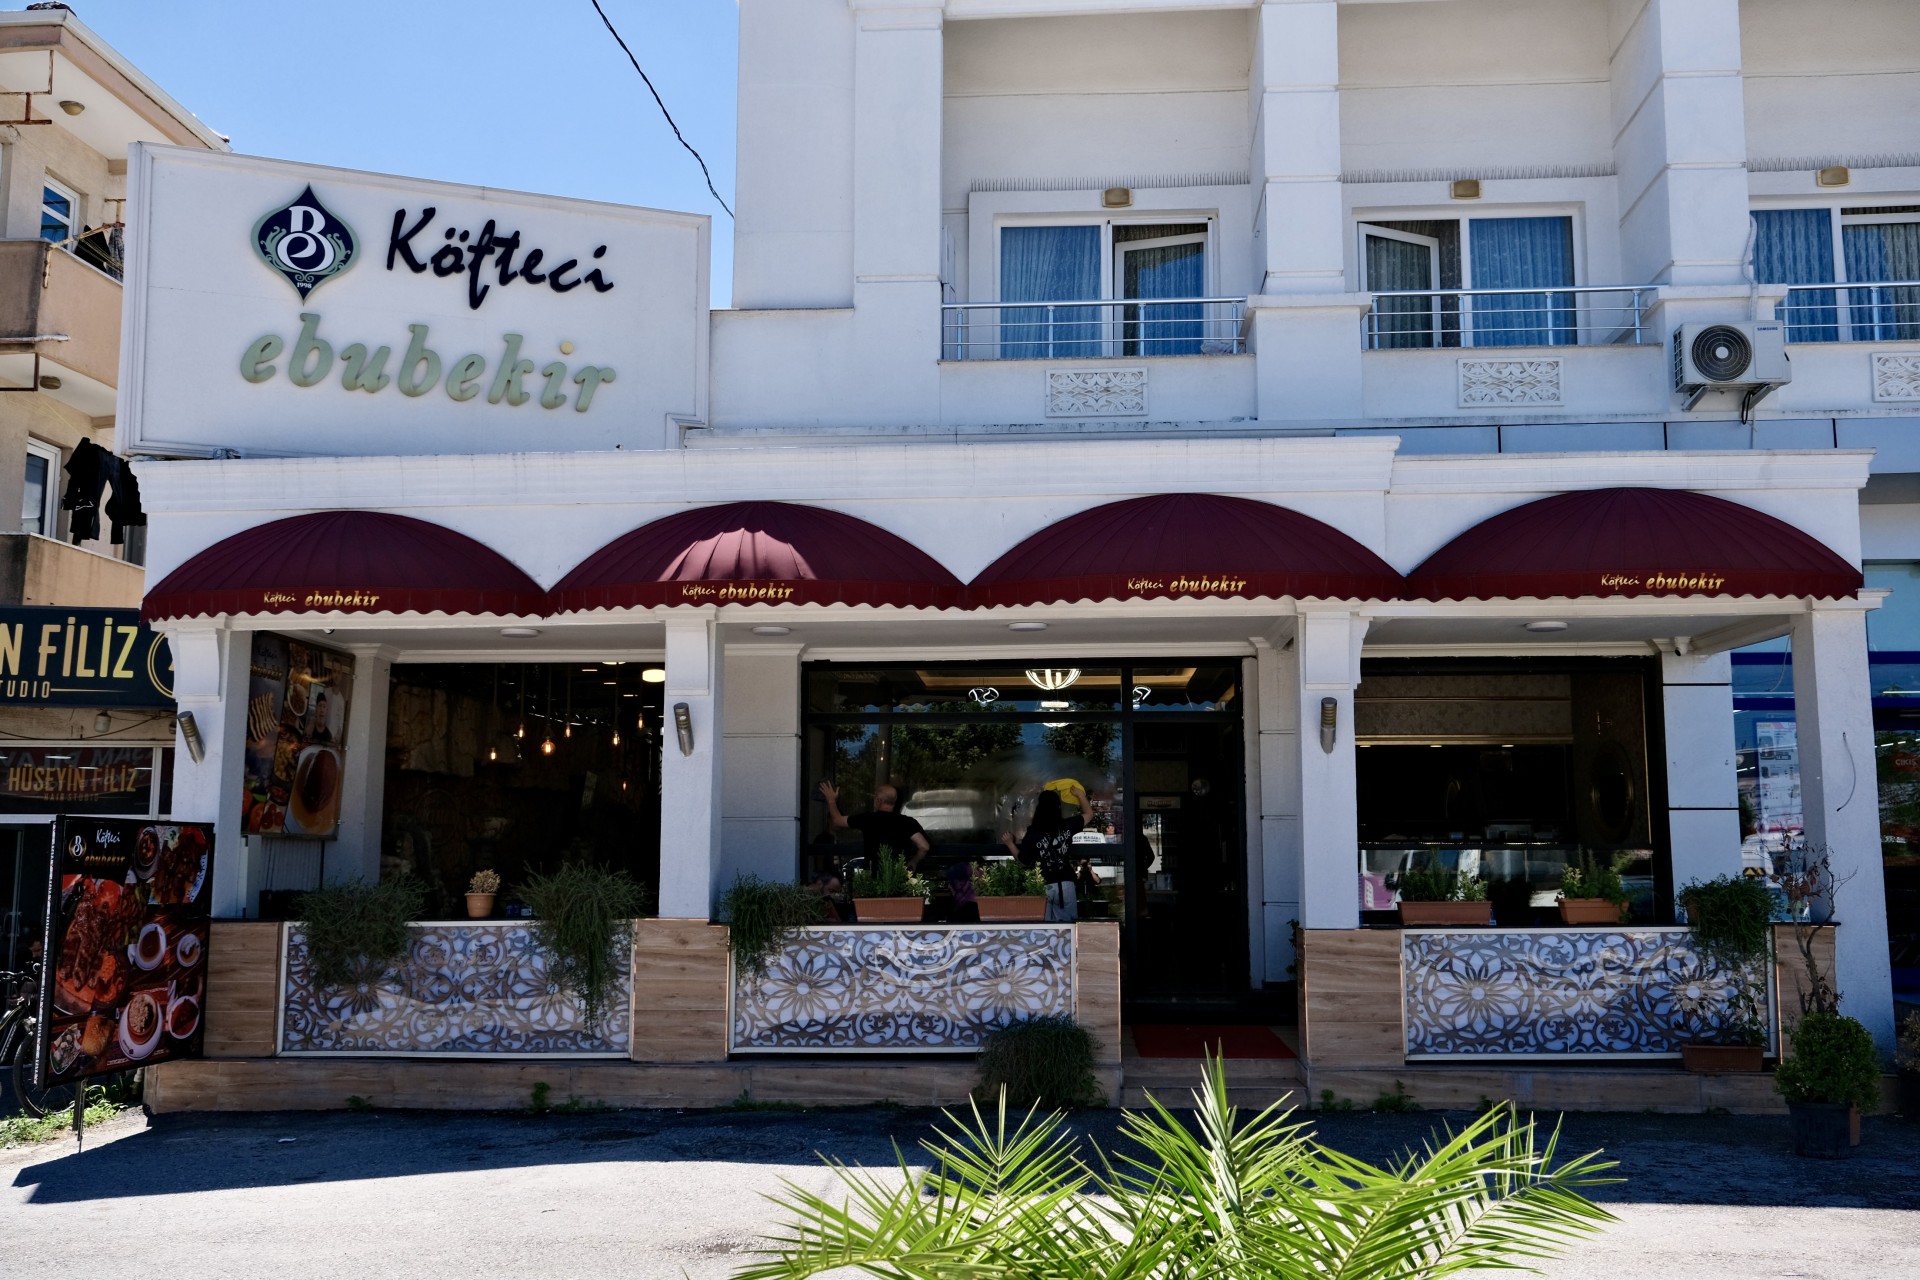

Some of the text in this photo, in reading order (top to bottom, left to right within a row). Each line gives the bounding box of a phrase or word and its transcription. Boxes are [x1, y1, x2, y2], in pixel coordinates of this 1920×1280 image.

[386, 207, 615, 310] Köfteci
[239, 313, 617, 413] ebubekir
[682, 582, 794, 600] Köfteci ebubekir
[1127, 575, 1247, 594] Köfteci ebubekir
[1601, 572, 1725, 591] Köfteci ebubekir
[263, 590, 380, 607] Köfteci ebubekir
[38, 616, 138, 678] FİLİZ
[8, 763, 86, 792] HÜSEYİN
